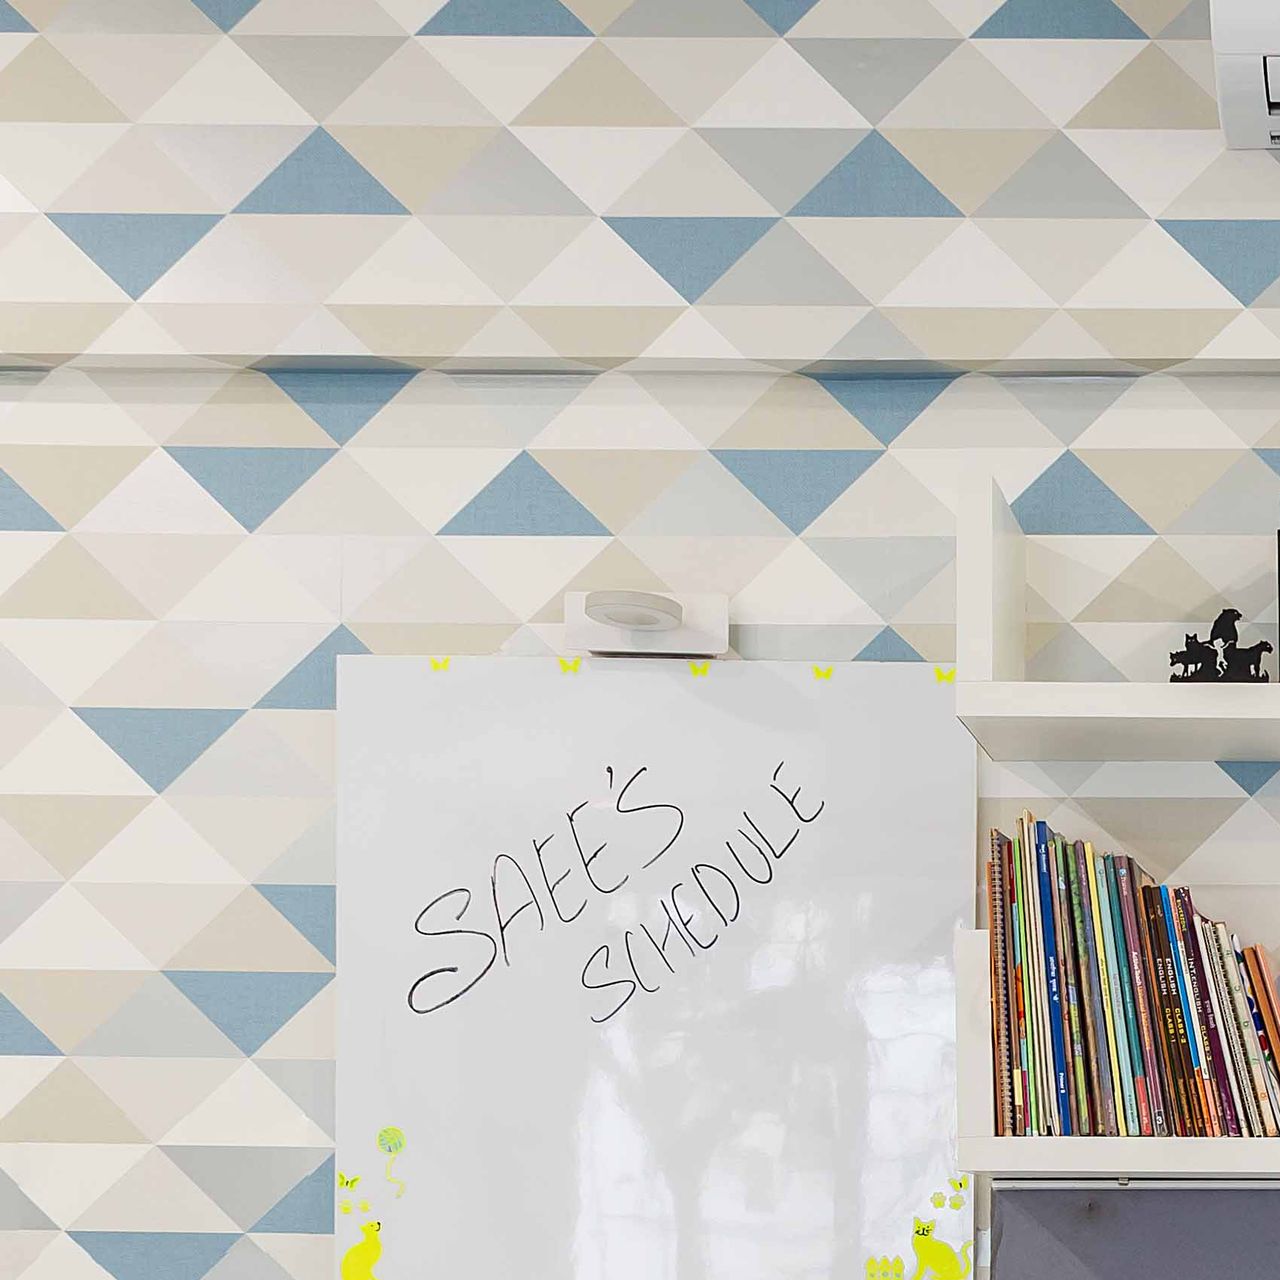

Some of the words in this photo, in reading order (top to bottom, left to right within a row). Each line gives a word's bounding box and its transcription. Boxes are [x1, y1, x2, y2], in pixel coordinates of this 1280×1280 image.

[406, 765, 686, 1015] SAEE'S
[581, 761, 825, 1023] SCHEDULE
[1155, 958, 1168, 995] ENGLISH
[1164, 958, 1177, 995] ENGLISH
